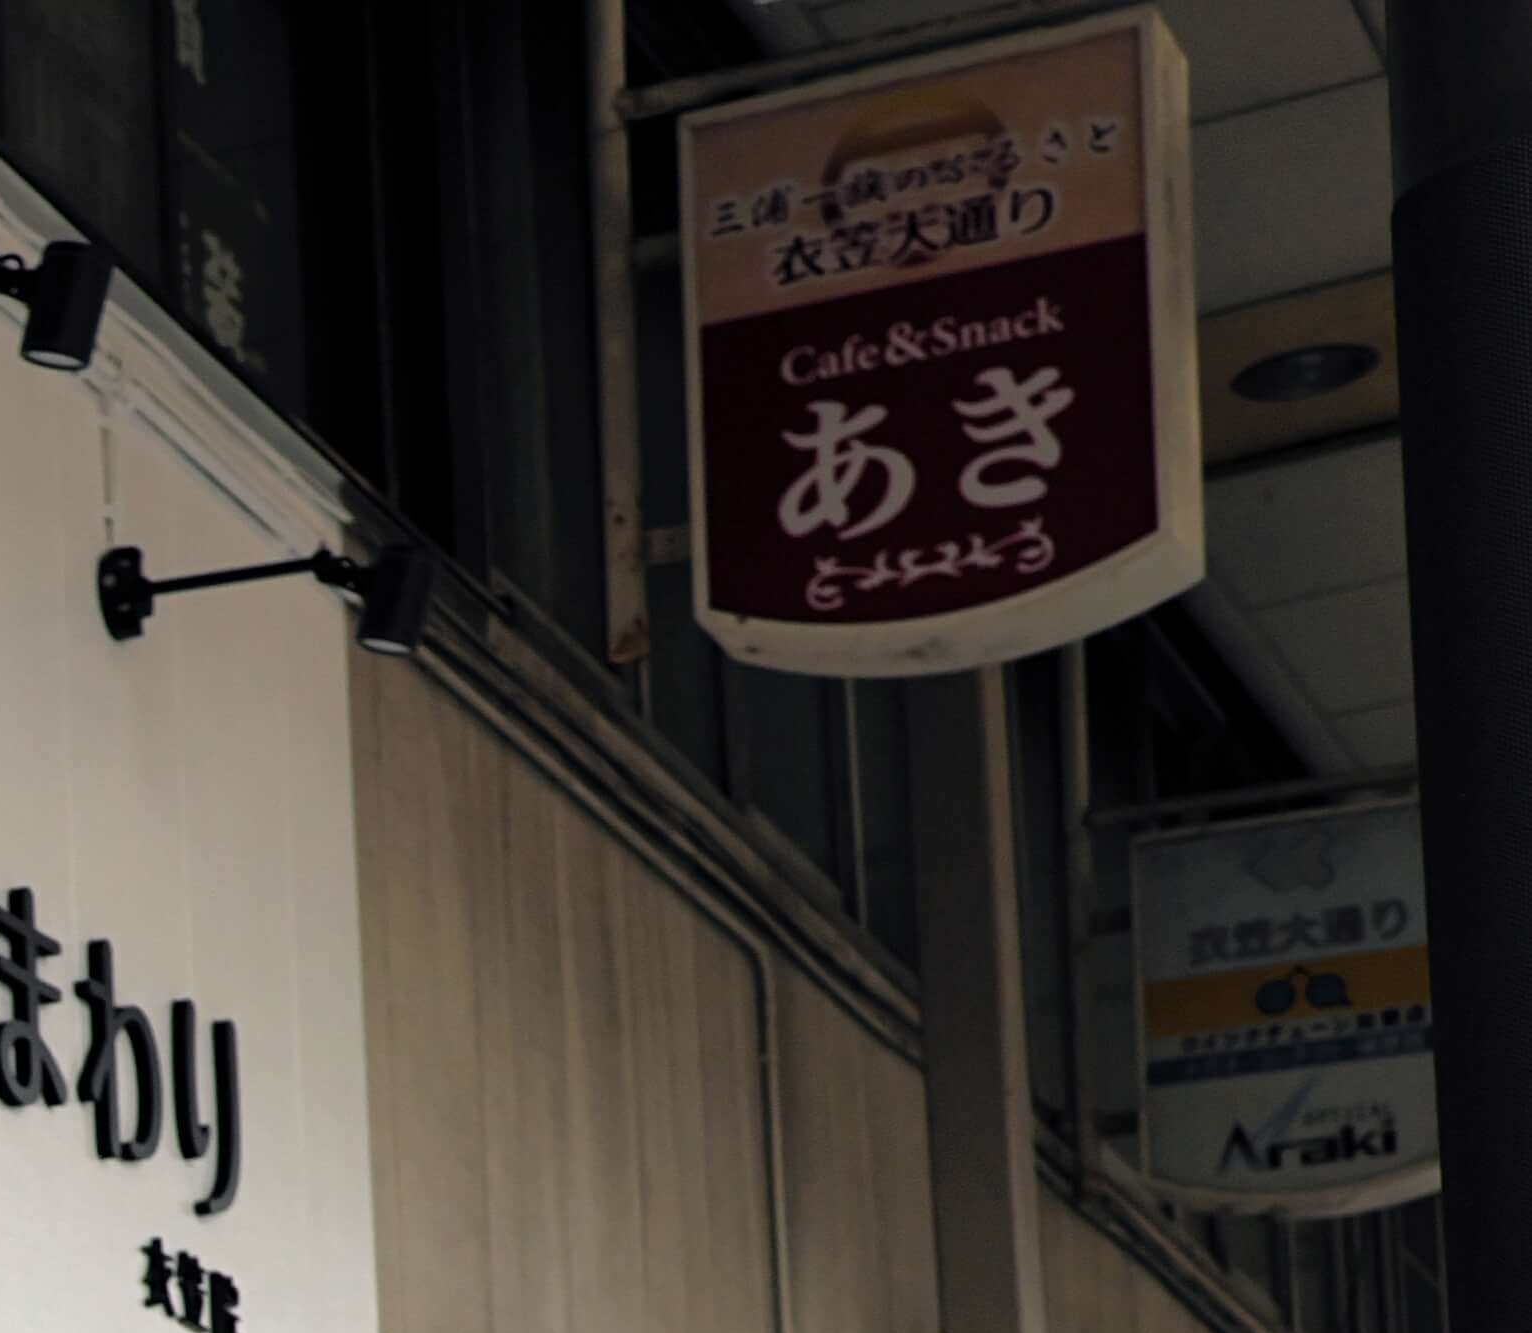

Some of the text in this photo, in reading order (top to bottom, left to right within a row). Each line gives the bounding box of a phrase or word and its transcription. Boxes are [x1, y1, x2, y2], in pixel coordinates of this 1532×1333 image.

[773, 187, 1056, 288] 衣笠大通り
[778, 365, 1075, 542] あき
